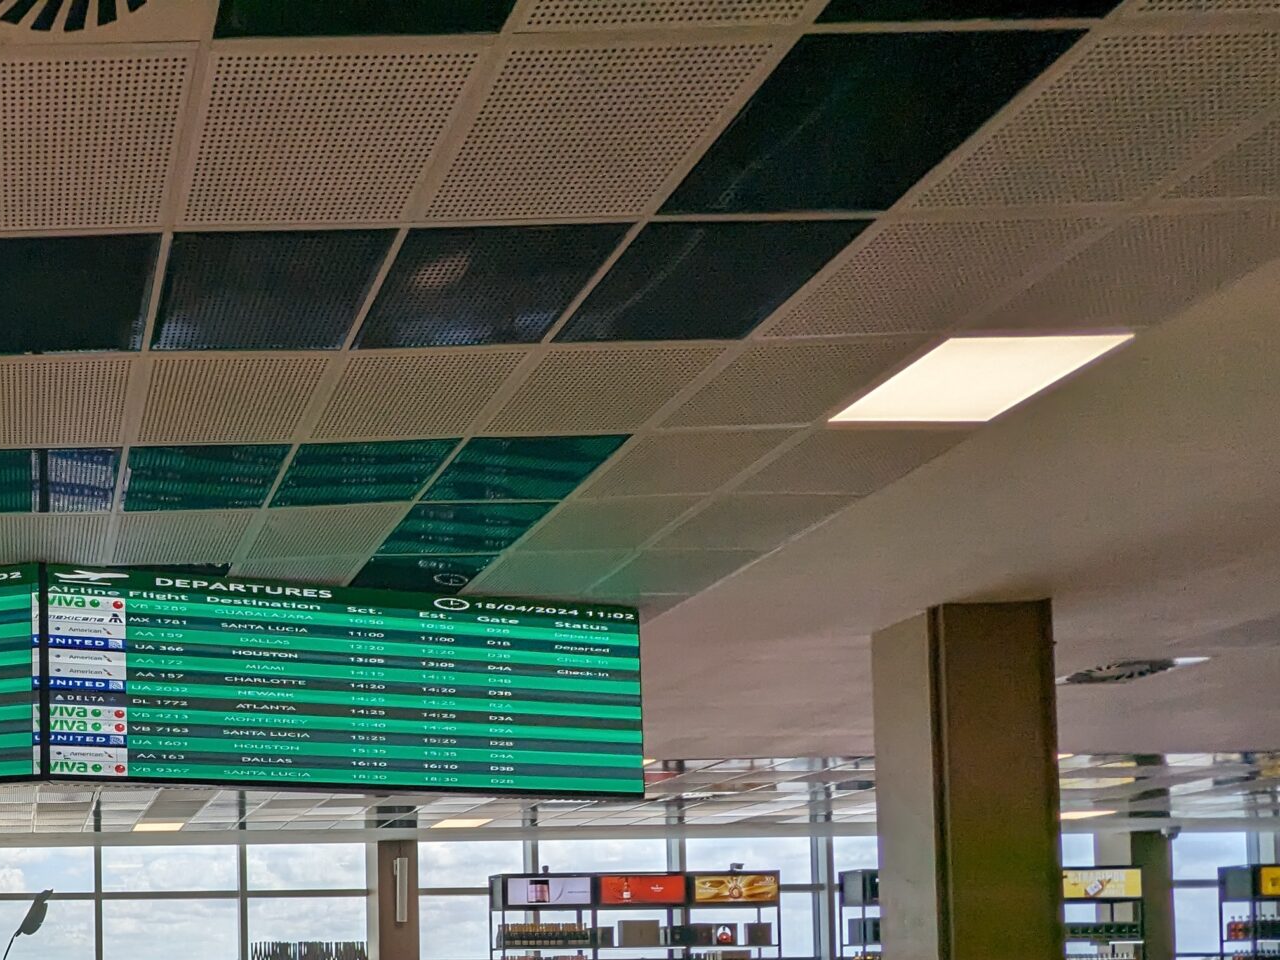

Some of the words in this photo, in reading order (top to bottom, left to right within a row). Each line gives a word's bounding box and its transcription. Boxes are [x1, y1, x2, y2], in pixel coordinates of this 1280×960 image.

[46, 585, 120, 595] Airline
[128, 591, 188, 601] Flight
[206, 596, 321, 609] Destination
[476, 616, 519, 624] Gate
[554, 621, 608, 630] Status
[154, 578, 333, 598] DEPARTURES
[474, 602, 578, 615] 18/04/2024
[585, 611, 634, 619] 11:02
[220, 622, 264, 630] SANTA
[267, 625, 307, 633] LUCIA
[554, 644, 610, 653] Departed
[34, 637, 105, 646] UNITED
[231, 649, 298, 658] HOUSTON
[34, 679, 105, 688] UNITED
[224, 675, 305, 685] CHARLOTTE
[66, 694, 105, 702] DELTA
[235, 703, 296, 711] ATLANTA
[35, 734, 106, 743] UNITED
